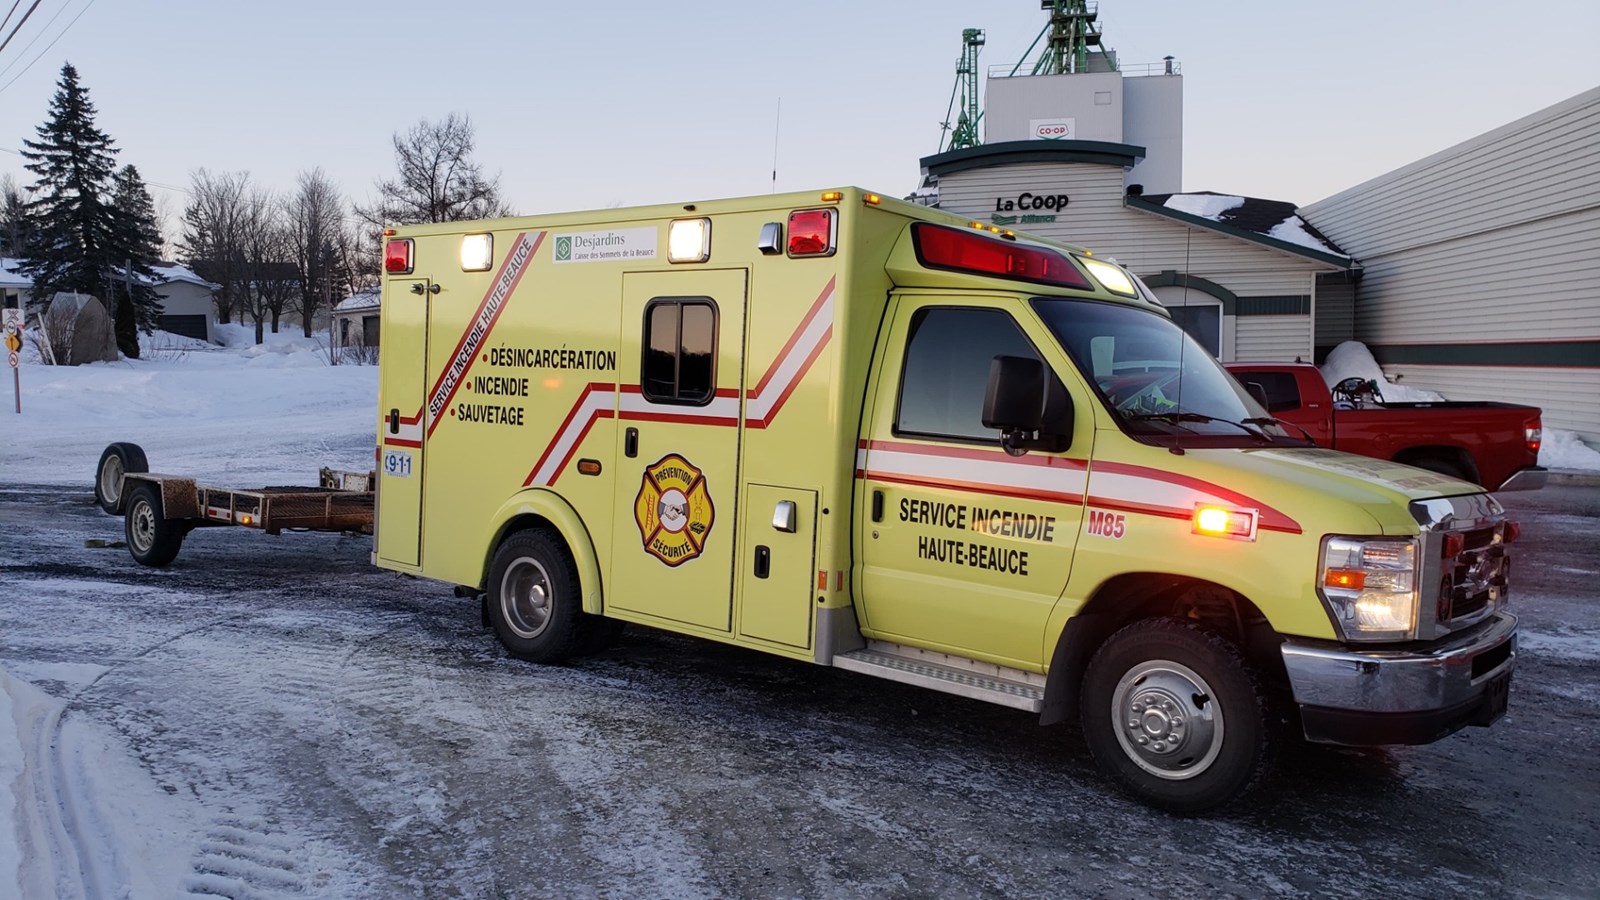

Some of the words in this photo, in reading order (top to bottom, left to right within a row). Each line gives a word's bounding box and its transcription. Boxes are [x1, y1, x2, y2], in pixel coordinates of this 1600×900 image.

[996, 197, 1014, 211] La
[1018, 192, 1069, 212] Coop
[575, 233, 625, 250] Desjardins
[590, 251, 599, 259] des
[599, 250, 621, 259] Sommets
[623, 249, 629, 257] de
[630, 249, 635, 257] la
[636, 248, 654, 256] Beauce
[429, 370, 457, 417] SERVICE
[453, 322, 485, 374] INCENDIE
[481, 238, 532, 325] HAUTE-BEAUCE
[491, 342, 616, 371] DÉSINCARCÉRATION
[474, 376, 529, 397] INCENDIE
[458, 403, 525, 426] SAUVETAGE
[655, 465, 694, 486] PRÉVENTION
[899, 497, 967, 530] SERVICE
[971, 507, 1056, 542] INCENDIE
[1087, 510, 1125, 539] M85
[652, 538, 692, 558] SÉCURITÉ
[918, 535, 1029, 576] HAUTE-BEAUCE
